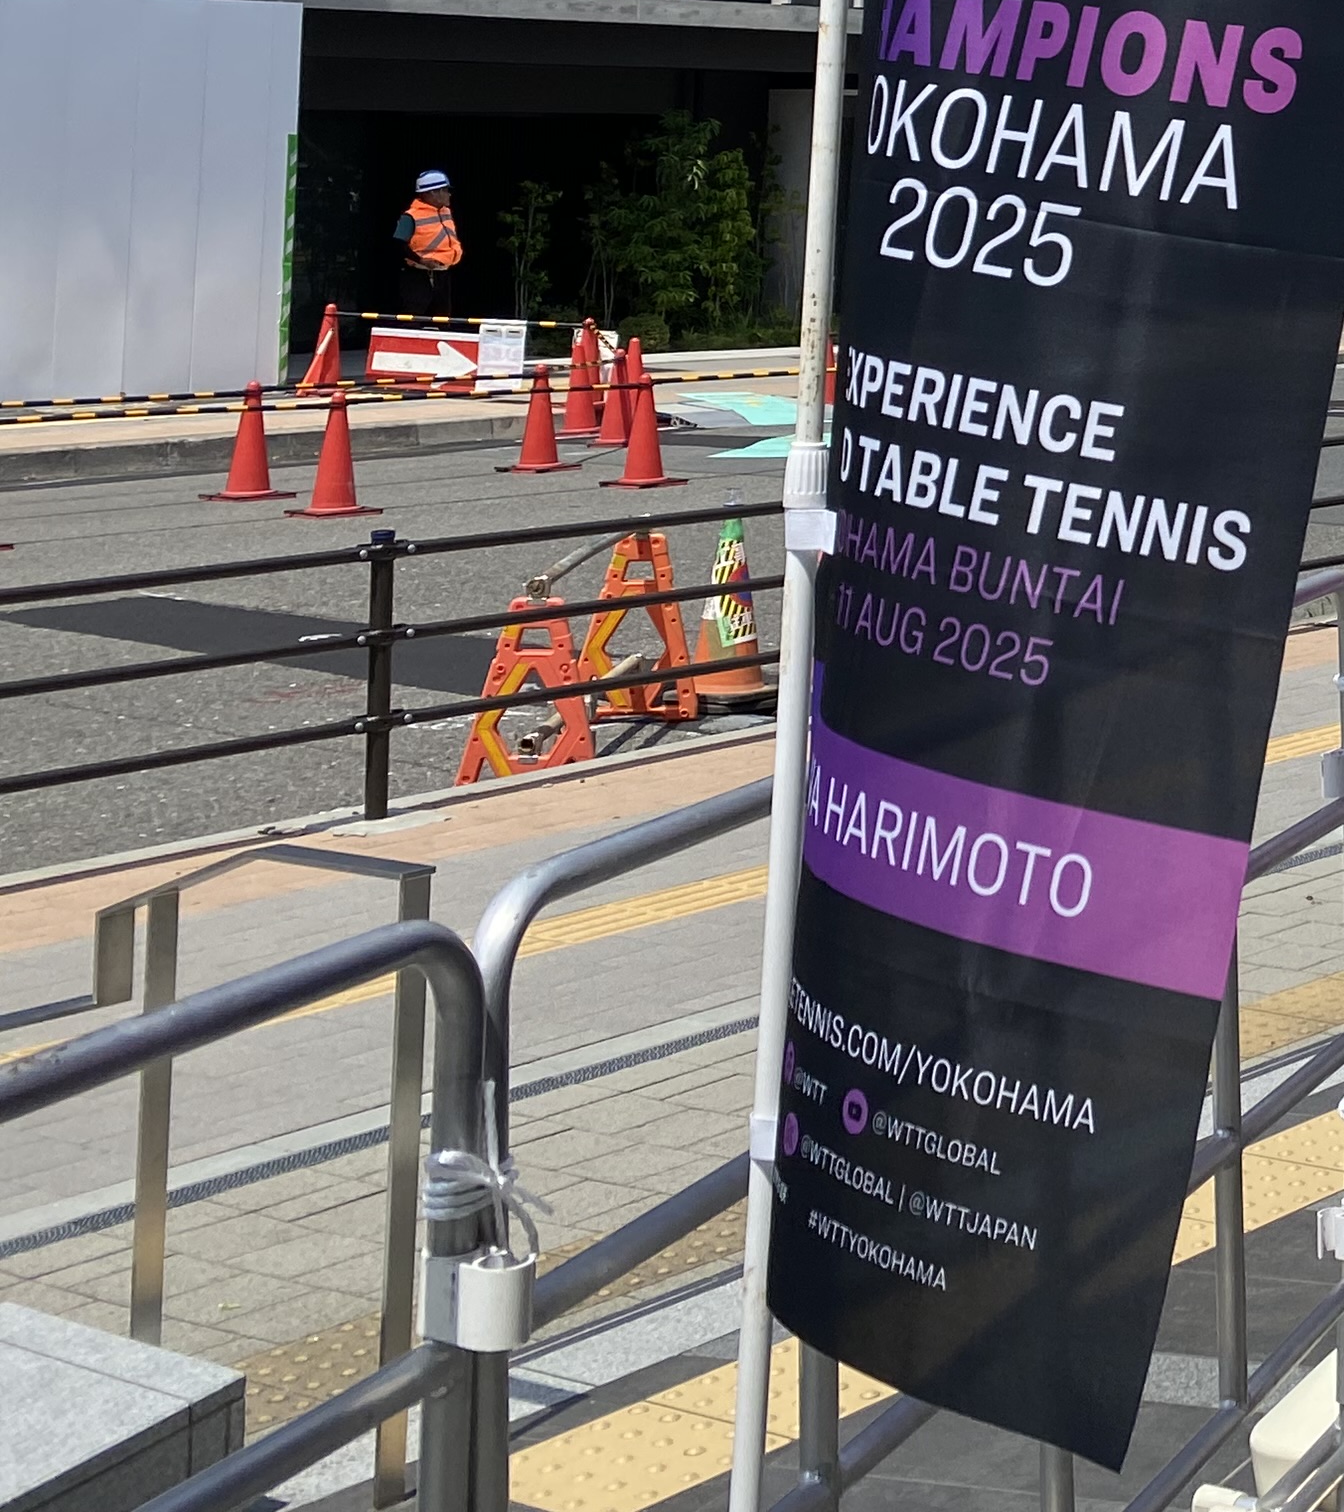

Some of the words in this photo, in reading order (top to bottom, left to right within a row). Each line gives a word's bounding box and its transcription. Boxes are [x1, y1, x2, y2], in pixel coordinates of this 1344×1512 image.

[879, 177, 1082, 288] 2025
[846, 346, 1125, 462] XPERIENCE
[858, 435, 1010, 527] TABLE
[1023, 474, 1252, 572] TENNIS
[854, 592, 925, 657] AUG
[933, 617, 1055, 687] 2025
[949, 544, 1127, 626] BUNTAI
[822, 776, 1094, 919] HARIMOTO
[801, 1133, 895, 1207] @WTTGLOBAL
[908, 1189, 1039, 1252] @WTTJAPAN
[872, 1110, 1002, 1176] @WTTGLOBAL
[807, 1209, 948, 1292] #WTTYOKOHAMA
